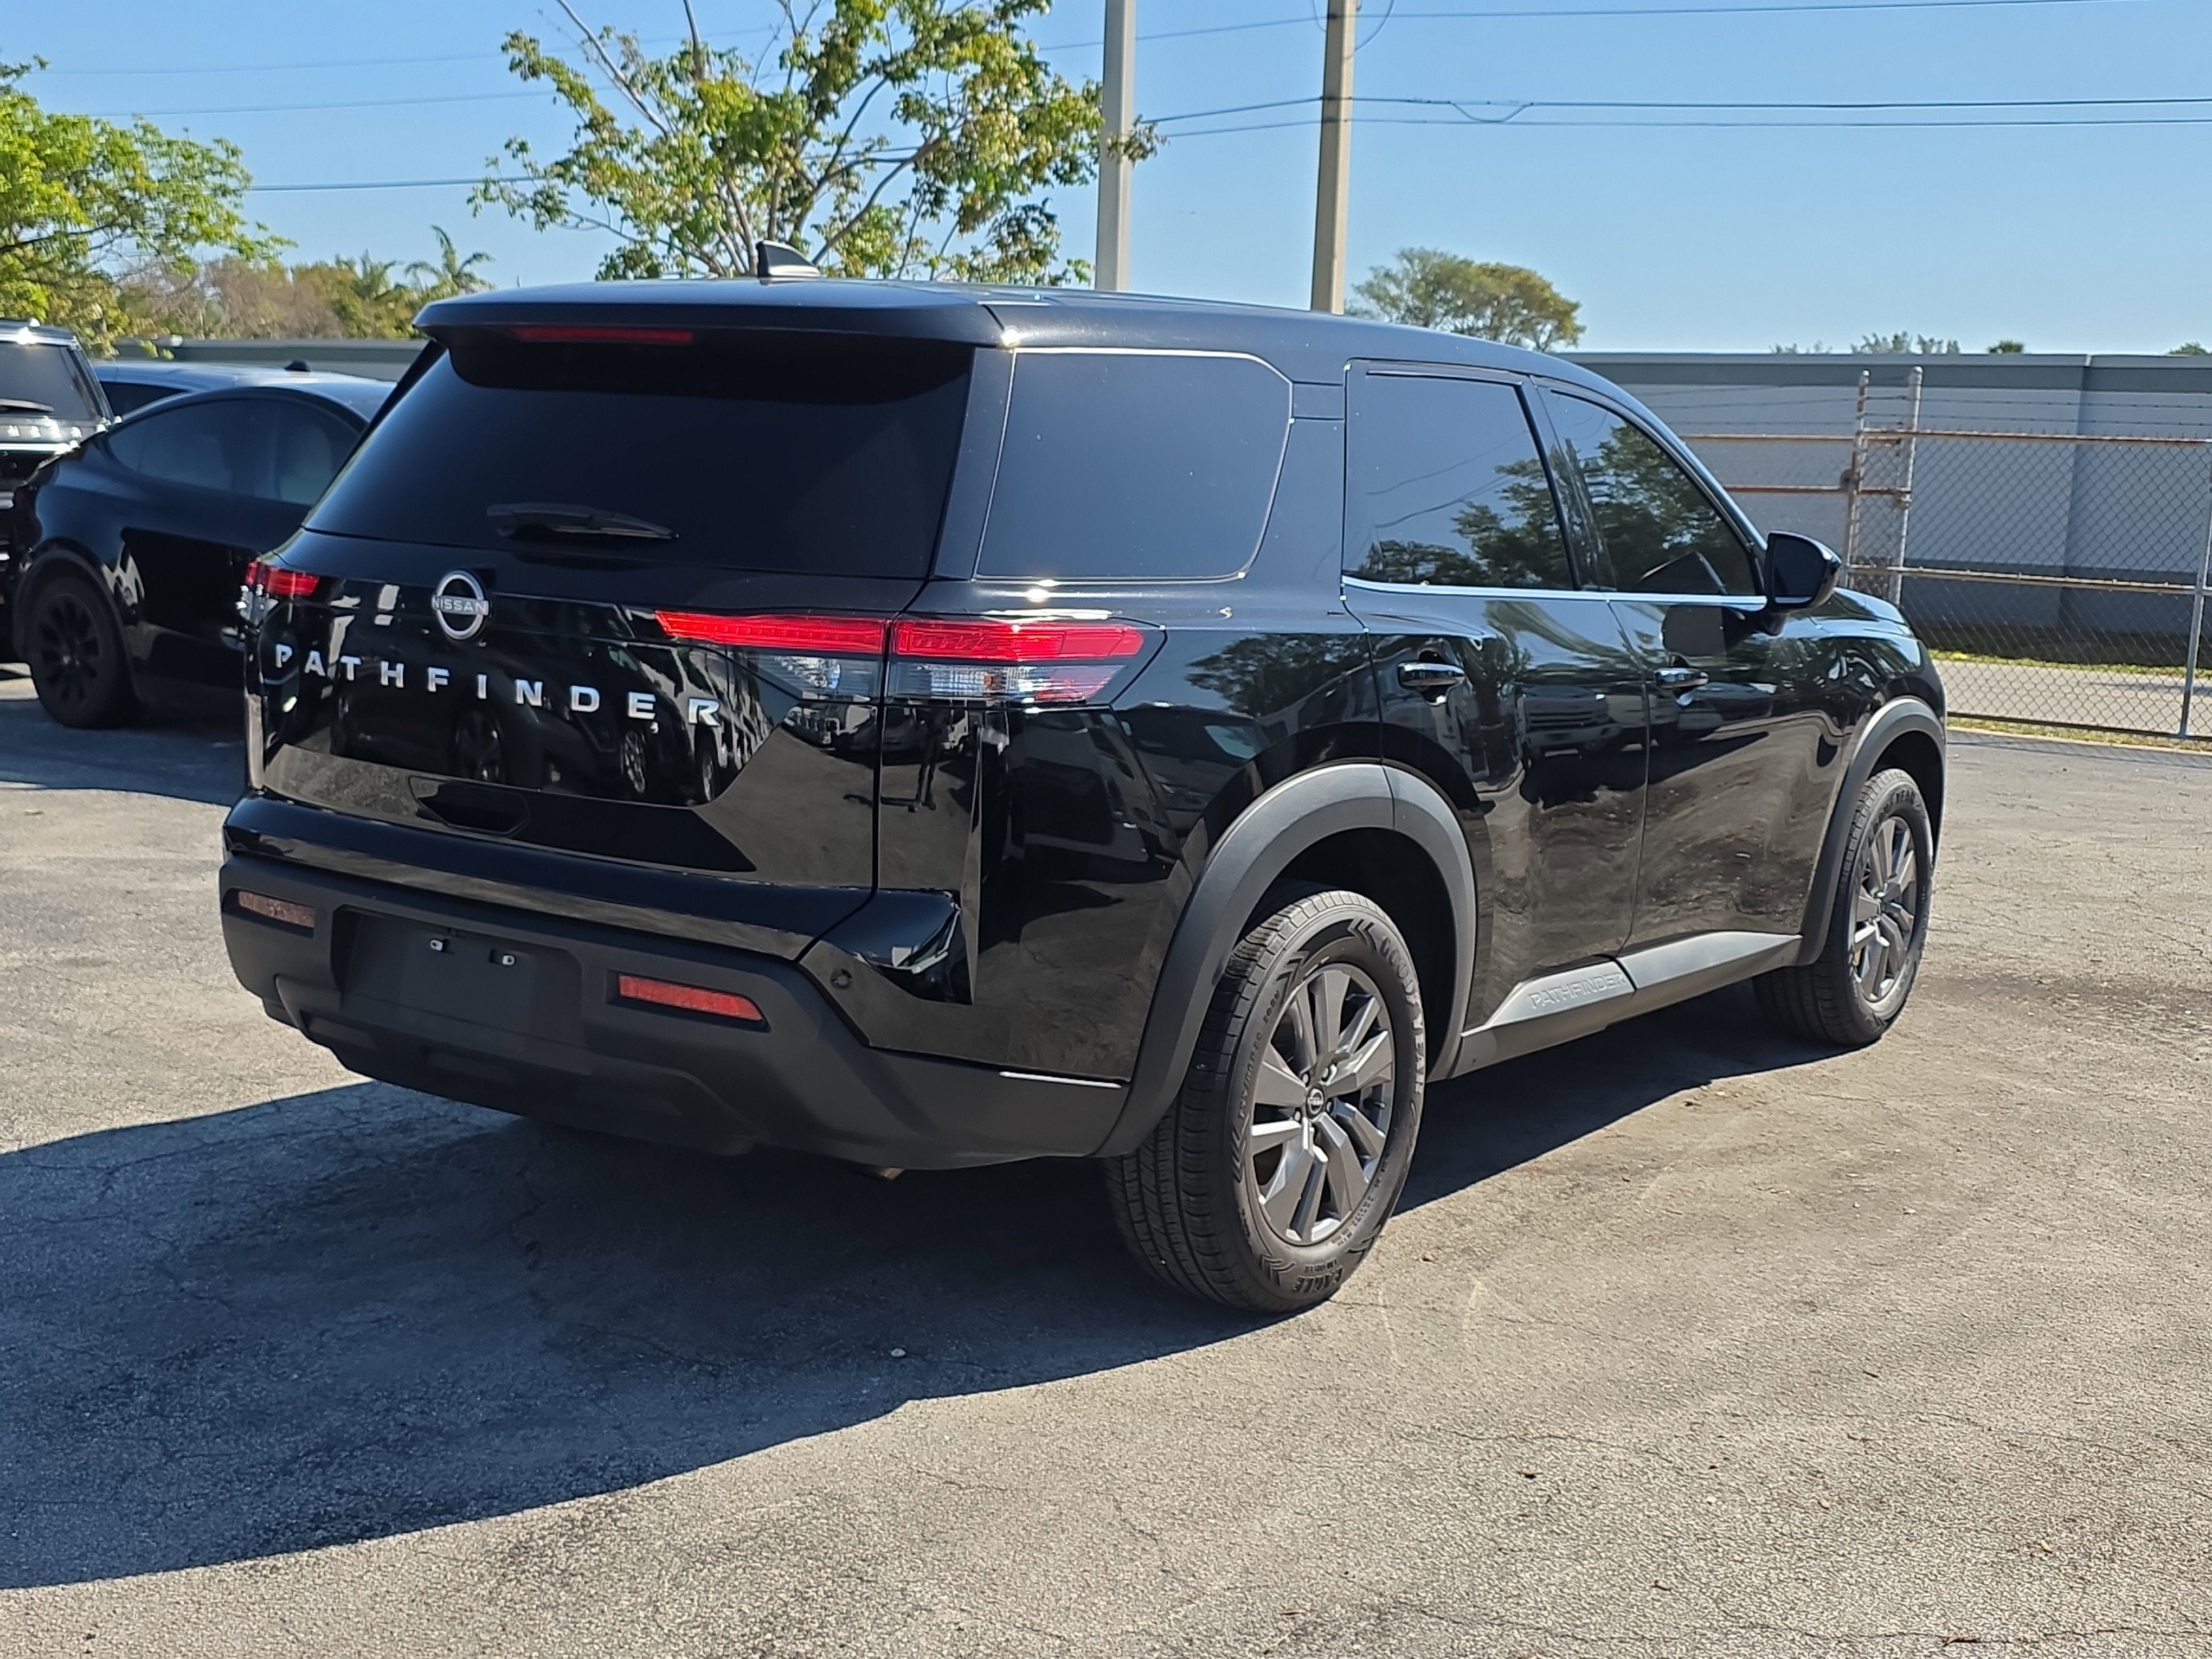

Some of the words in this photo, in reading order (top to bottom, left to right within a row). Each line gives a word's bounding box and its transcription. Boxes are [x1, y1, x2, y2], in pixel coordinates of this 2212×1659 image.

[432, 596, 487, 613] NISSAN
[275, 643, 721, 728] PATHFINDER
[1527, 972, 1627, 1010] PATHFINDER
